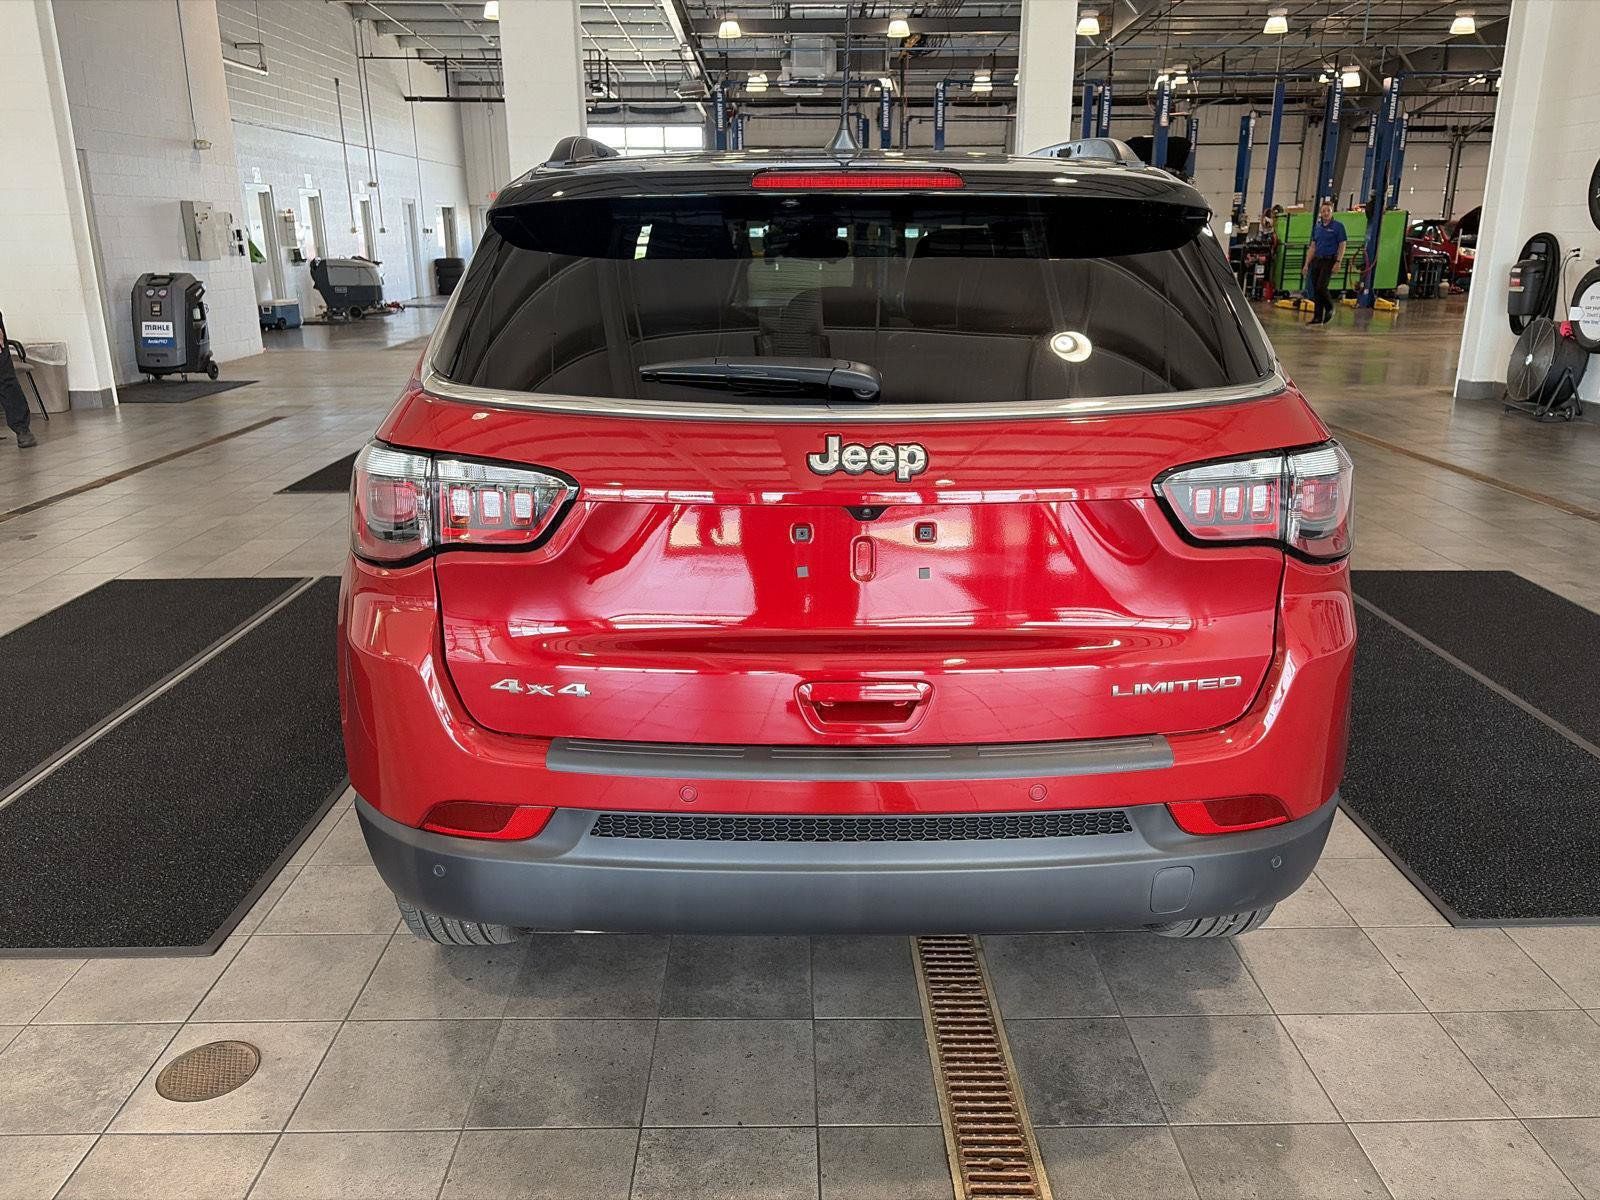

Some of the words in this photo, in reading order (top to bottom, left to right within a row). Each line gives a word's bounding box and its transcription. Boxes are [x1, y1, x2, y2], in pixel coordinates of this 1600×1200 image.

[1102, 101, 1110, 126] ROTARY
[1161, 96, 1170, 122] ROTARY
[1332, 94, 1341, 120] ROTARY
[1388, 93, 1398, 119] ROTARY
[808, 435, 926, 480] Jeep
[1112, 675, 1242, 696] LIMITED
